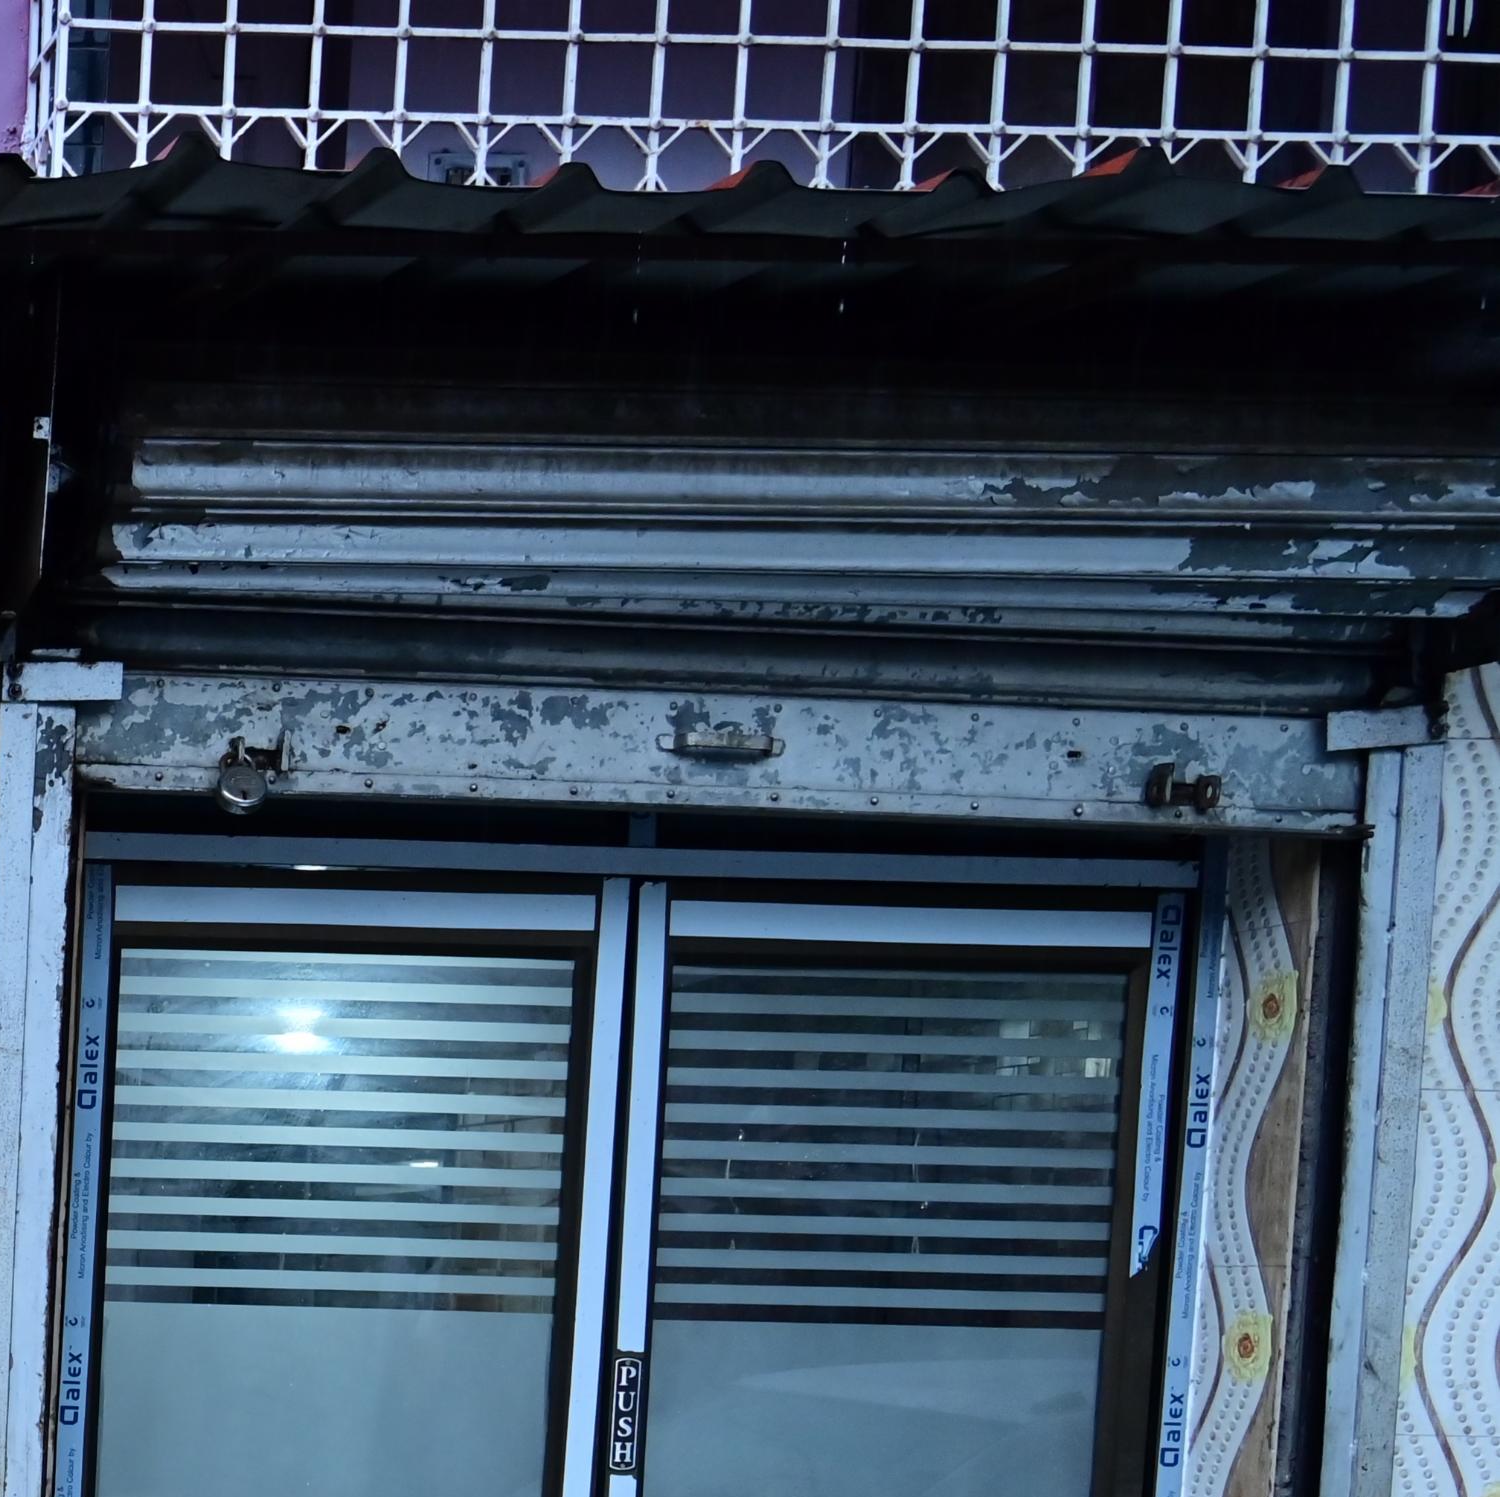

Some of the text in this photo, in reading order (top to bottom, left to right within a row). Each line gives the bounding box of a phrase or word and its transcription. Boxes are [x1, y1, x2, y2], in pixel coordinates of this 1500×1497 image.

[83, 1144, 92, 1168] Colour
[72, 1180, 81, 1208] Coating
[81, 1170, 90, 1196] Electro
[81, 1199, 89, 1213] and
[70, 1210, 79, 1239] Powder
[79, 1215, 90, 1252] Anodising
[77, 1253, 86, 1279] Micron
[614, 1366, 637, 1463] PUSH
[66, 1458, 74, 1483] Colour
